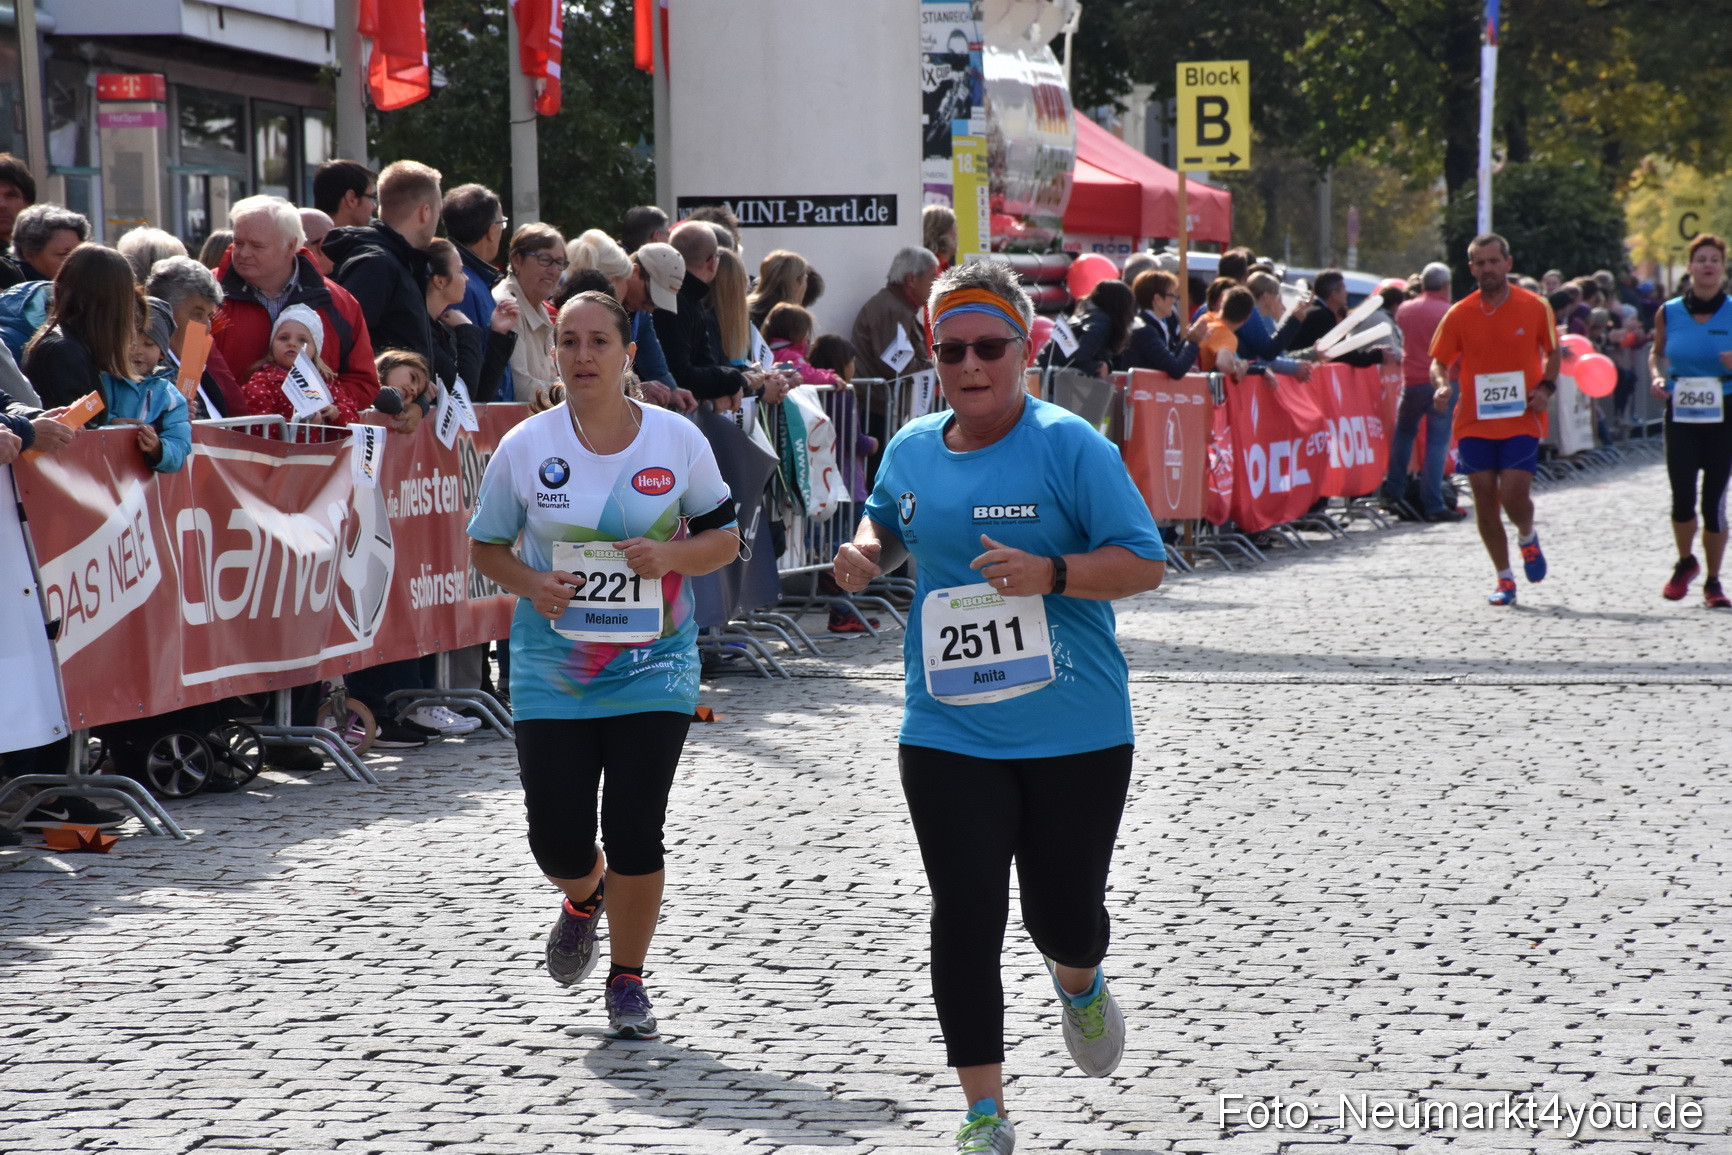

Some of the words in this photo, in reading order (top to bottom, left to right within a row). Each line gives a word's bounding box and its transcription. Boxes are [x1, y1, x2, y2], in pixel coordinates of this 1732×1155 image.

[122, 76, 141, 98] T
[1185, 66, 1241, 87] Block
[1196, 95, 1232, 147] B
[678, 198, 889, 225] wMINI-Partl.de
[1679, 212, 1699, 240] C
[1483, 385, 1518, 402] 2574
[1679, 390, 1715, 406] 2649
[387, 490, 399, 519] die
[400, 462, 459, 518] meisten
[638, 474, 671, 488] Hervis
[536, 492, 570, 502] PARTL
[972, 504, 1039, 520] BOCK
[46, 557, 101, 644] DAS
[107, 508, 152, 604] NEUE
[569, 571, 641, 602] 2221
[962, 593, 1005, 607] BOCK
[585, 612, 628, 625] Melanie
[940, 616, 1024, 661] 2511
[973, 669, 1006, 685] Anita
